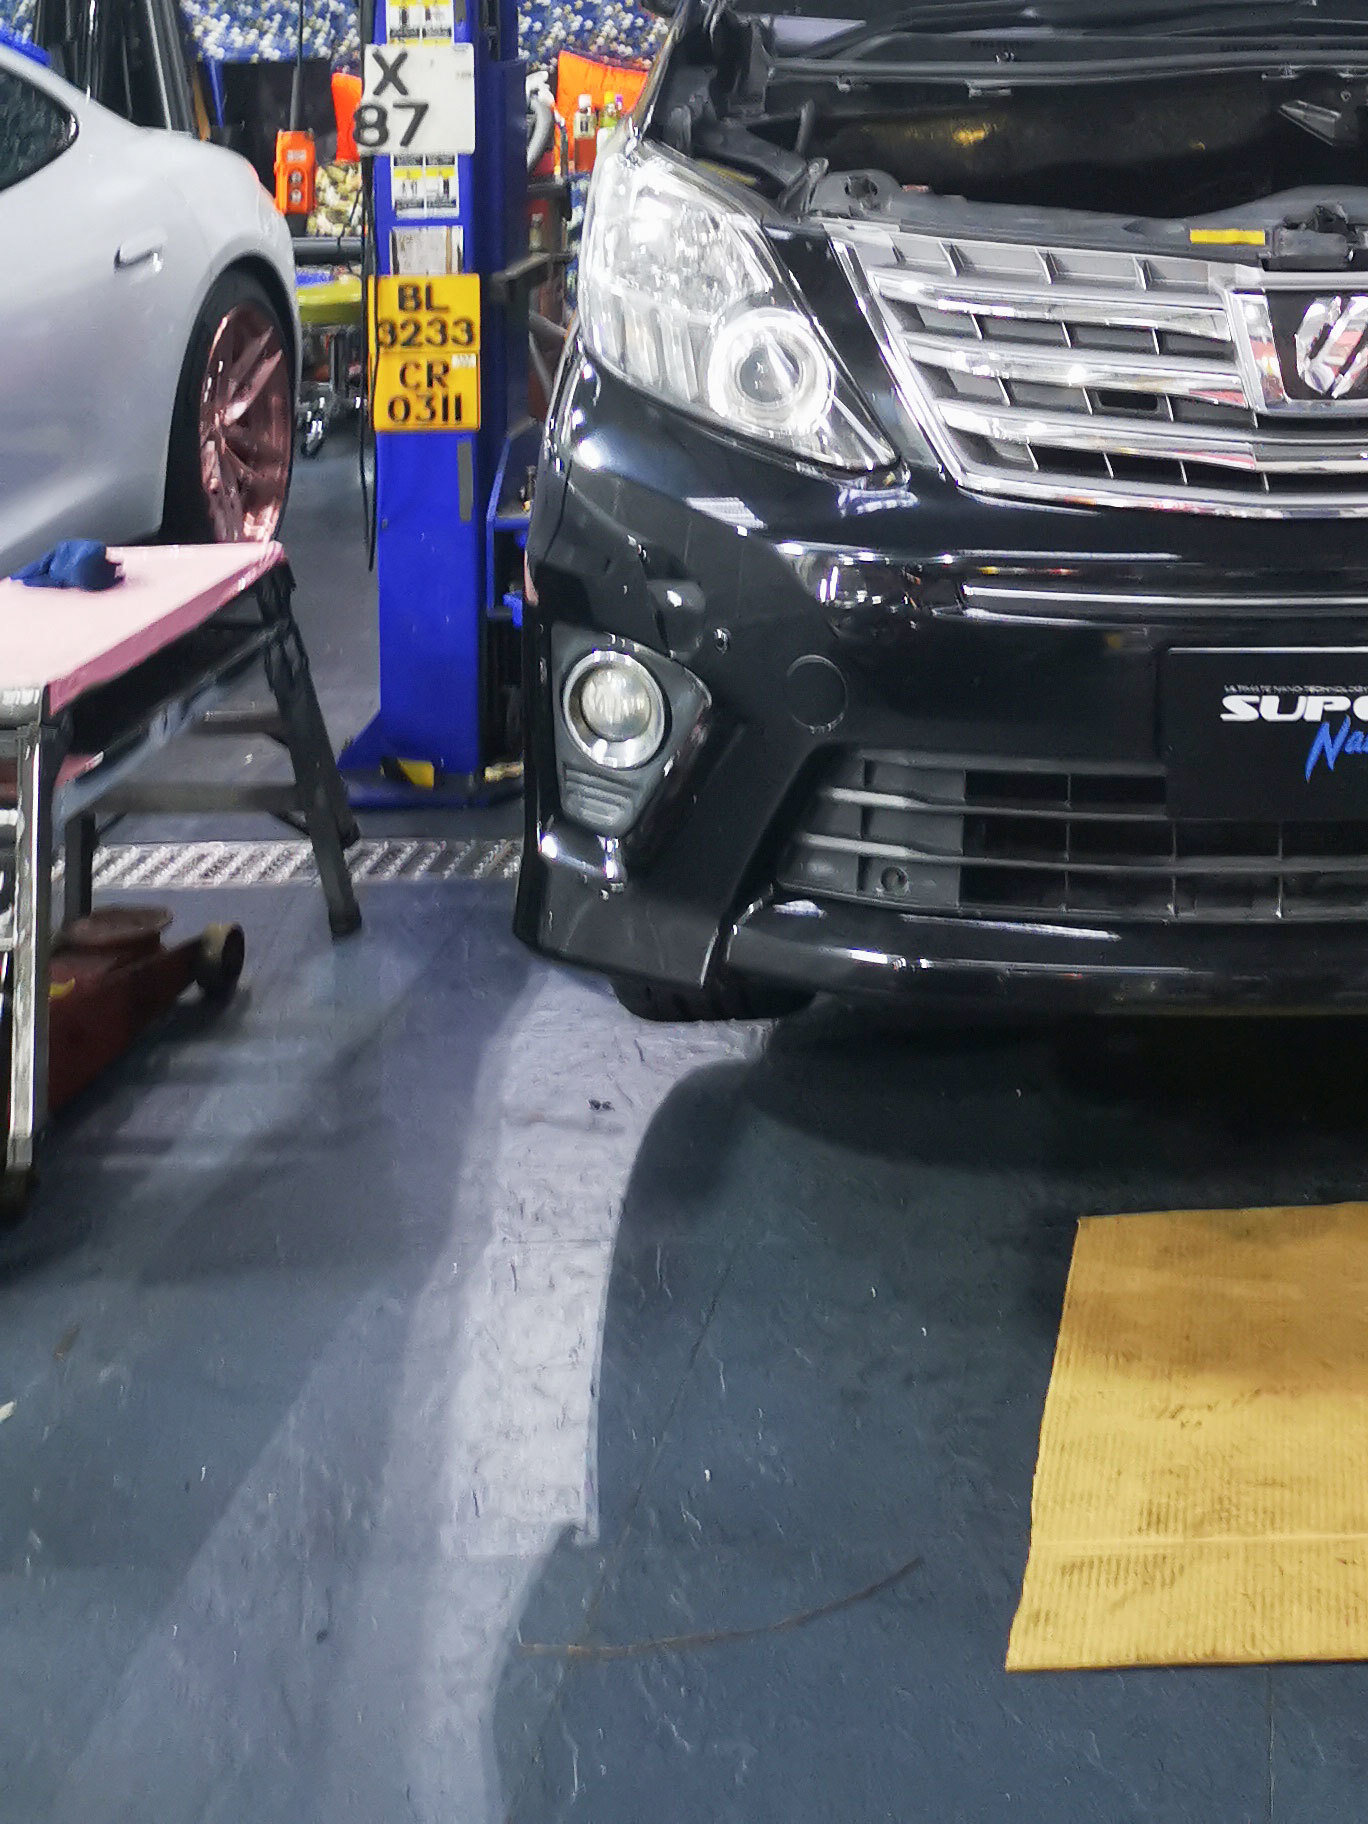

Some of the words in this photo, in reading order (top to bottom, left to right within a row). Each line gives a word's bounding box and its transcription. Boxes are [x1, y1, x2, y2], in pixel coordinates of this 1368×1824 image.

[372, 50, 409, 96] X
[353, 102, 429, 147] 87
[398, 283, 450, 313] BL
[400, 360, 450, 389] CR
[387, 394, 462, 423] 0311
